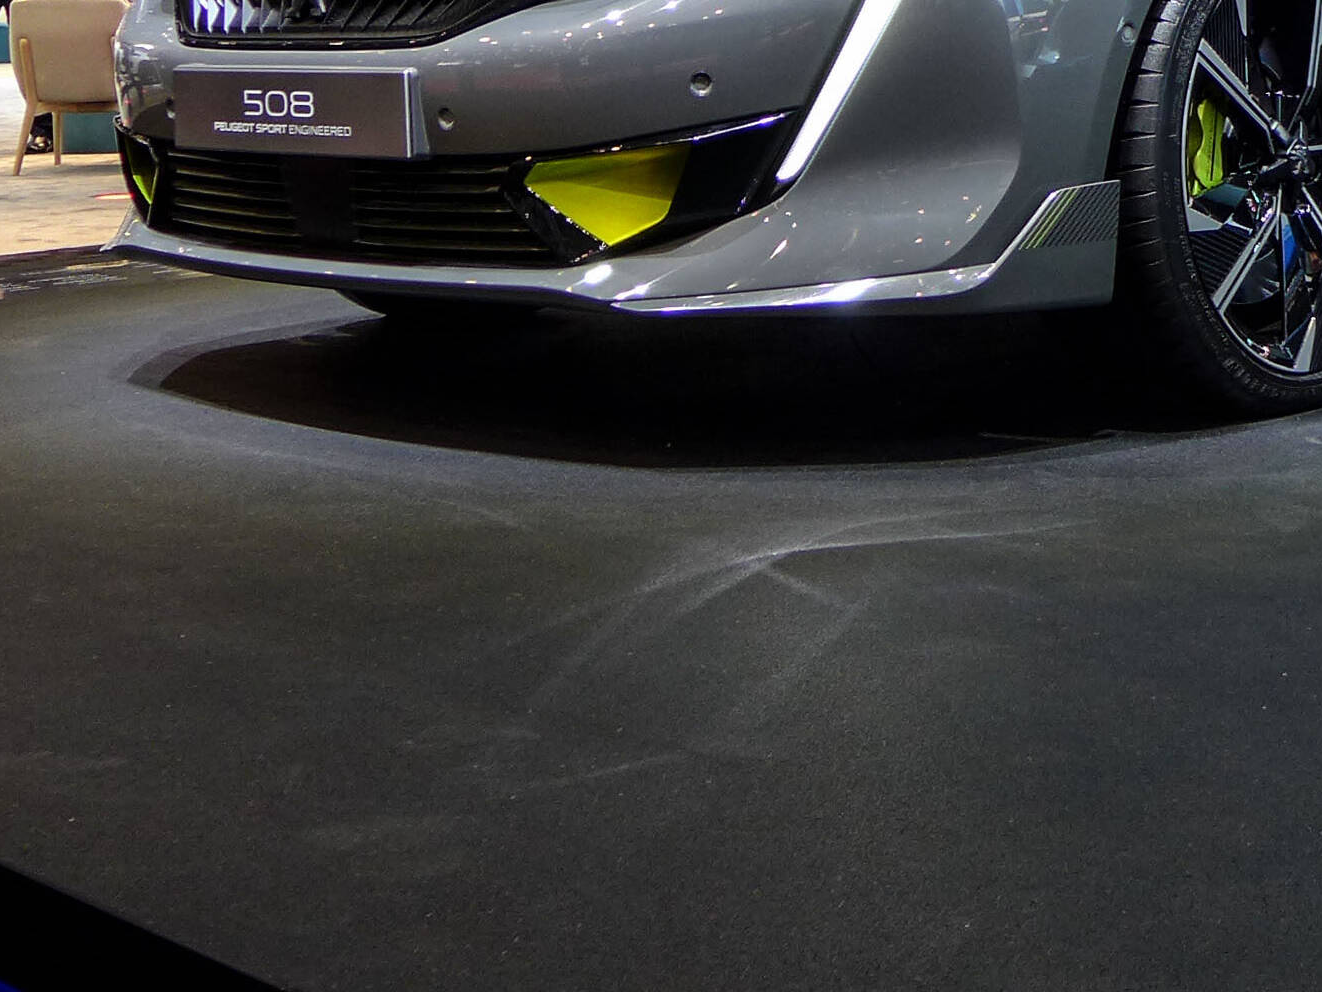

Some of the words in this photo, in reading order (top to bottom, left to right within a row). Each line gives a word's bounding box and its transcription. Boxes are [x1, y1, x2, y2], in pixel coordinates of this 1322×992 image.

[243, 89, 314, 118] 508
[214, 121, 254, 134] PEUGEOT
[256, 122, 287, 135] SPORT
[288, 124, 352, 137] ENGINEERED
